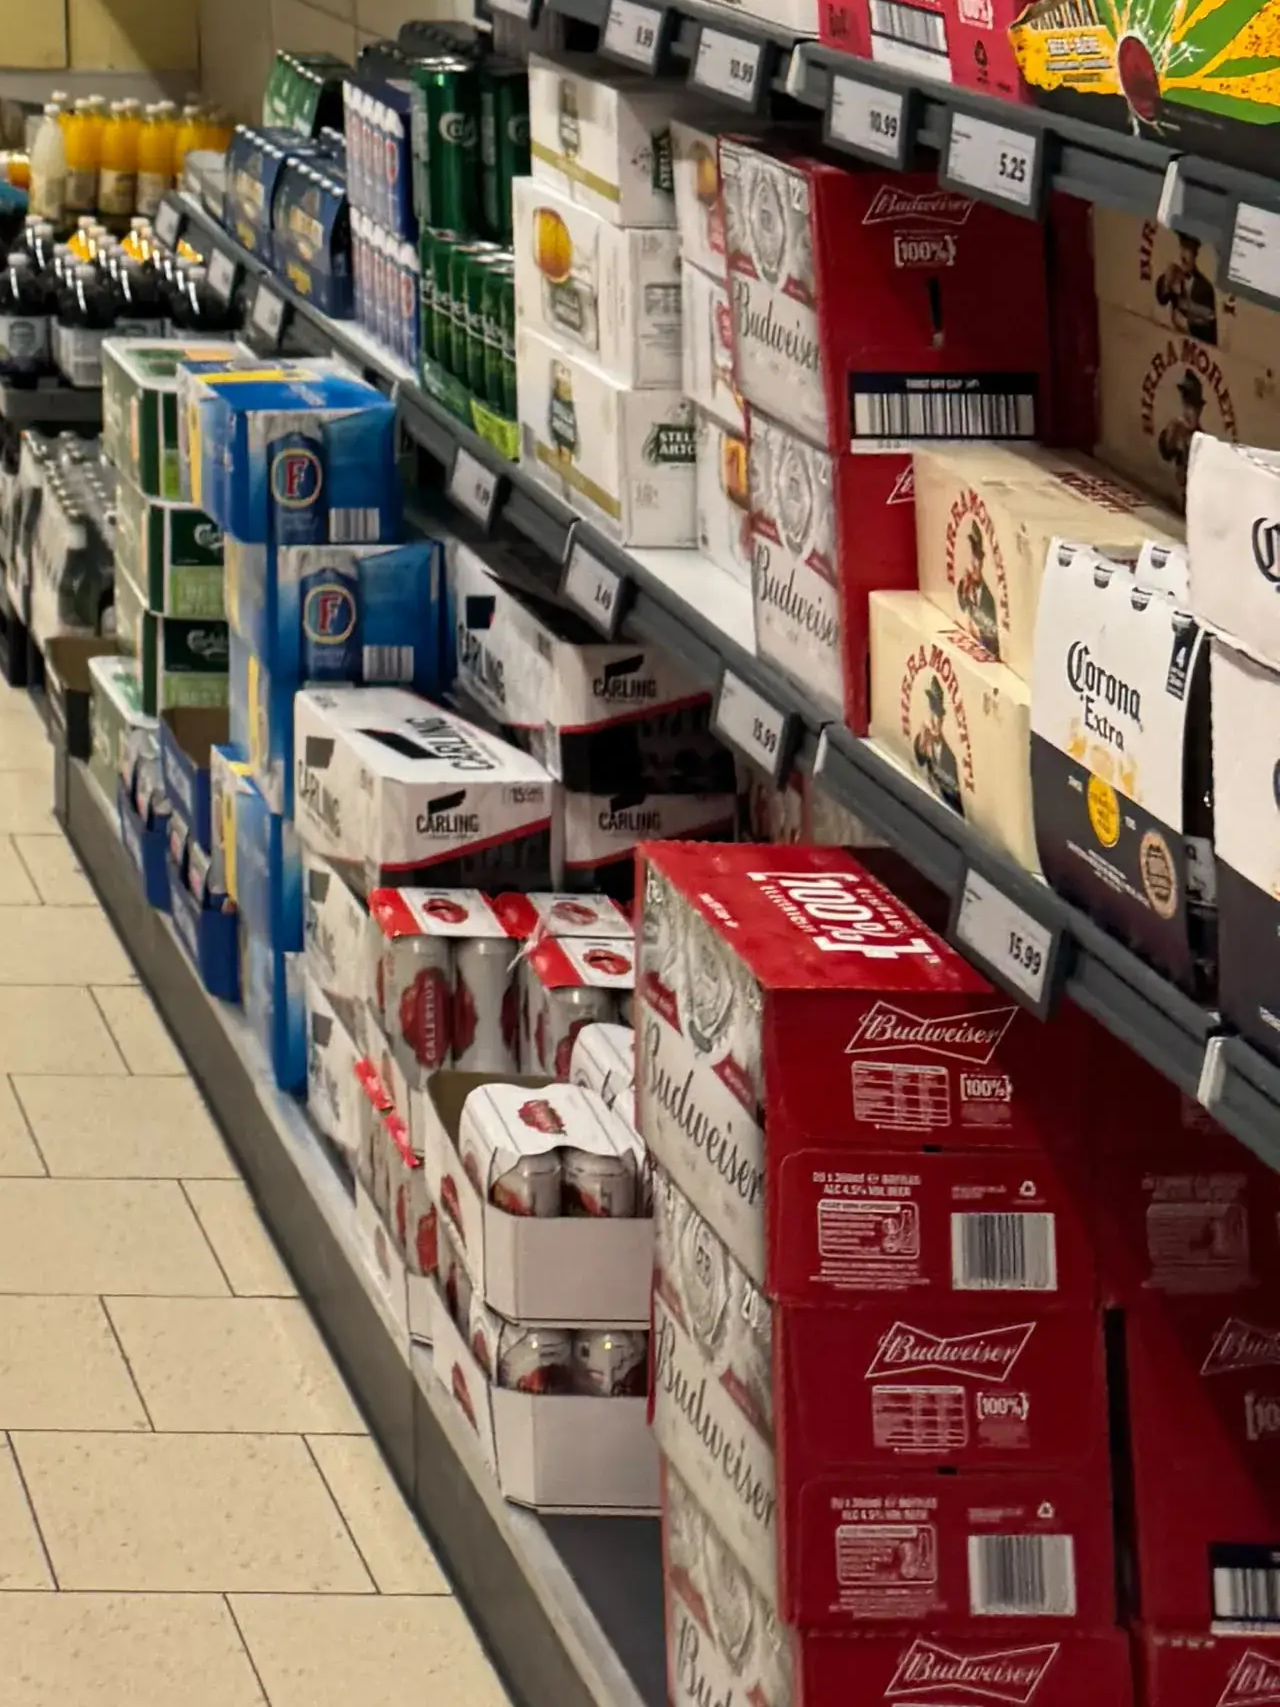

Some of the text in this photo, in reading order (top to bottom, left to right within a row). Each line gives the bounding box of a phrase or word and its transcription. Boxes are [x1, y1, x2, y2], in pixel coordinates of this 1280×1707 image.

[729, 58, 754, 83] 10.99
[870, 109, 897, 137] 10.99
[998, 153, 1026, 183] 5.25
[900, 237, 947, 263] 100%
[737, 280, 822, 376] Budweiser
[1140, 342, 1179, 437] BIRRA
[659, 431, 697, 443] STEL
[659, 444, 697, 456] ARTO
[946, 492, 968, 585] BIRRA
[754, 552, 841, 650] Budweiser
[1175, 646, 1187, 669] 4
[592, 676, 657, 698] CARLING
[1067, 640, 1143, 727] Corona
[901, 643, 975, 794] BIRRA MORETTI
[1083, 693, 1125, 755] Extra
[404, 716, 496, 772] CARLING
[752, 720, 778, 754] 15.99
[415, 812, 480, 837] CARLING
[597, 810, 662, 833] CARLING
[780, 879, 901, 942] 100%
[1007, 931, 1042, 976] 15.99
[858, 1013, 1000, 1044] Budweiser
[965, 1079, 1006, 1097] 100%
[642, 1025, 763, 1198] Budweiser
[878, 1335, 1018, 1365] Budweiser
[981, 1397, 1025, 1416] 100%
[656, 1331, 776, 1523] Budweiser
[900, 1652, 1042, 1683] Budweiser
